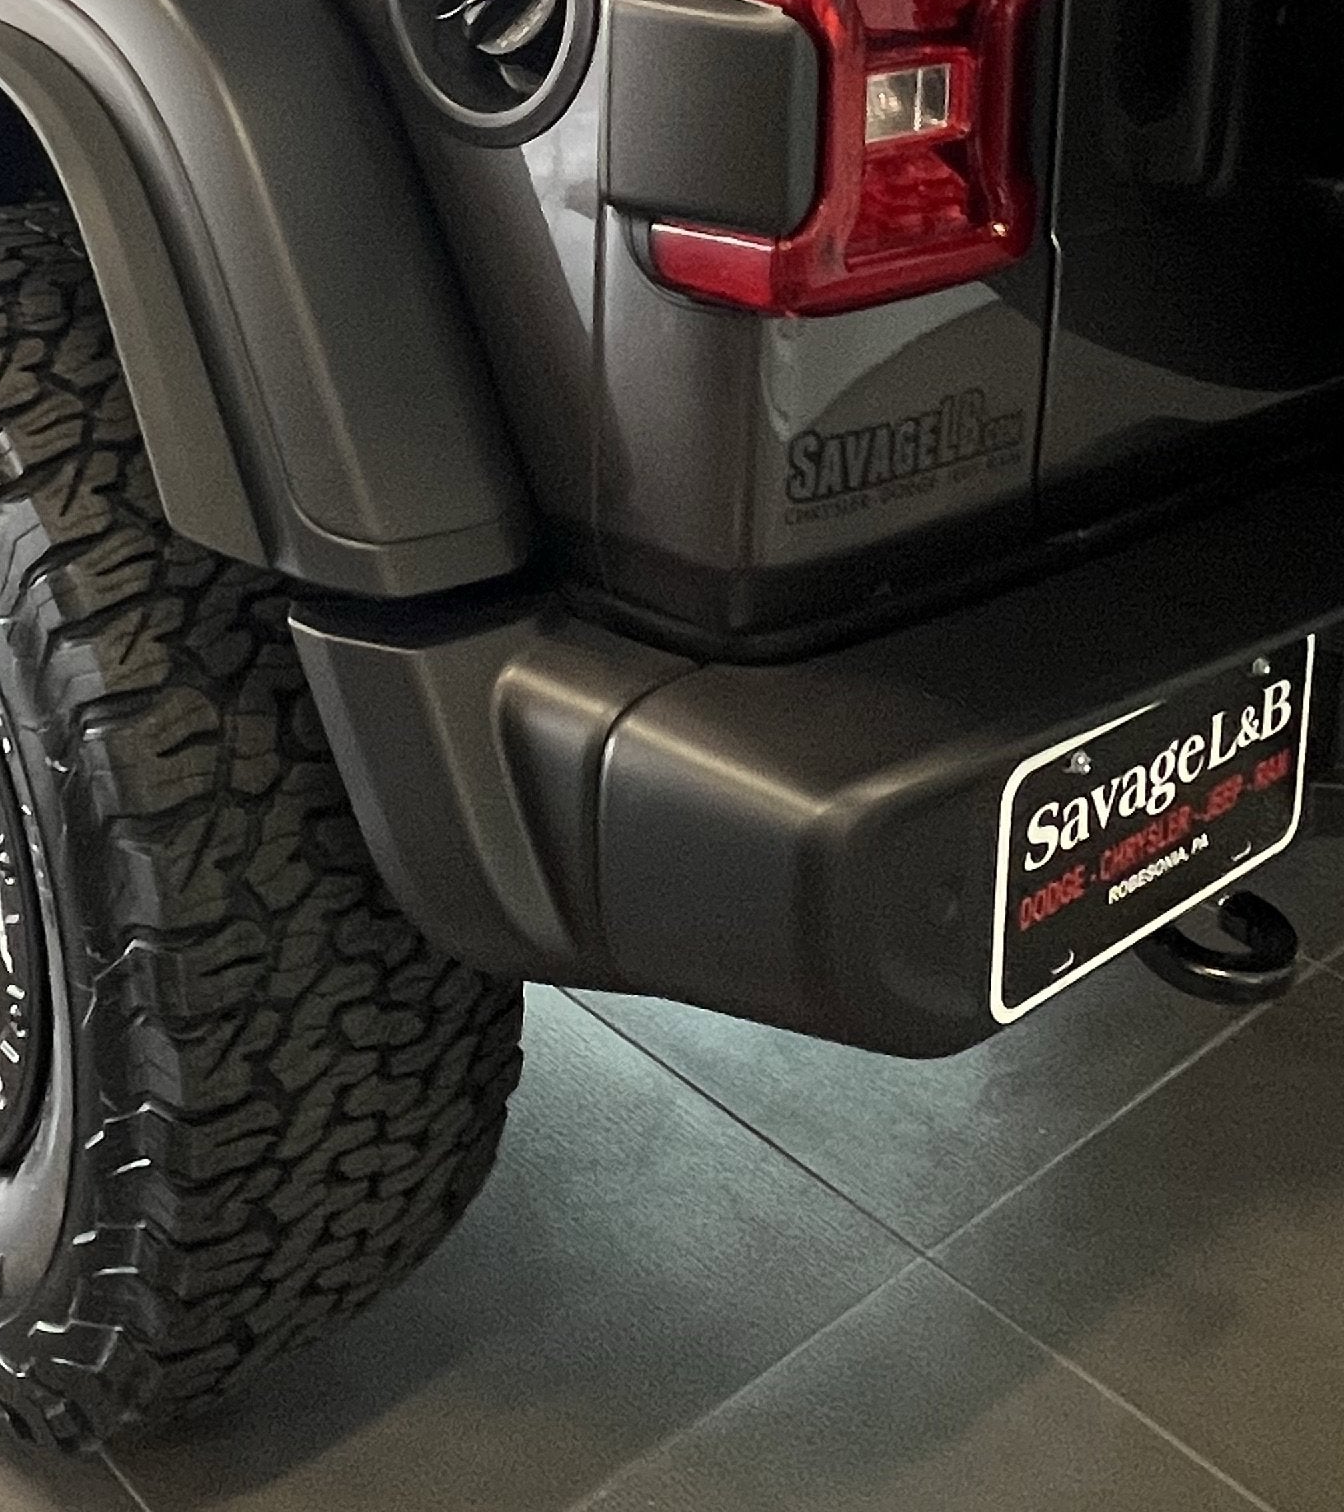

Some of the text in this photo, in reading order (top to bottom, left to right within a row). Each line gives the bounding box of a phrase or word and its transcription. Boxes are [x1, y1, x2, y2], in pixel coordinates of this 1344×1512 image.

[1018, 864, 1087, 932] DODGE
[1098, 804, 1193, 882] CHRYSLER
[1190, 832, 1210, 855] PA
